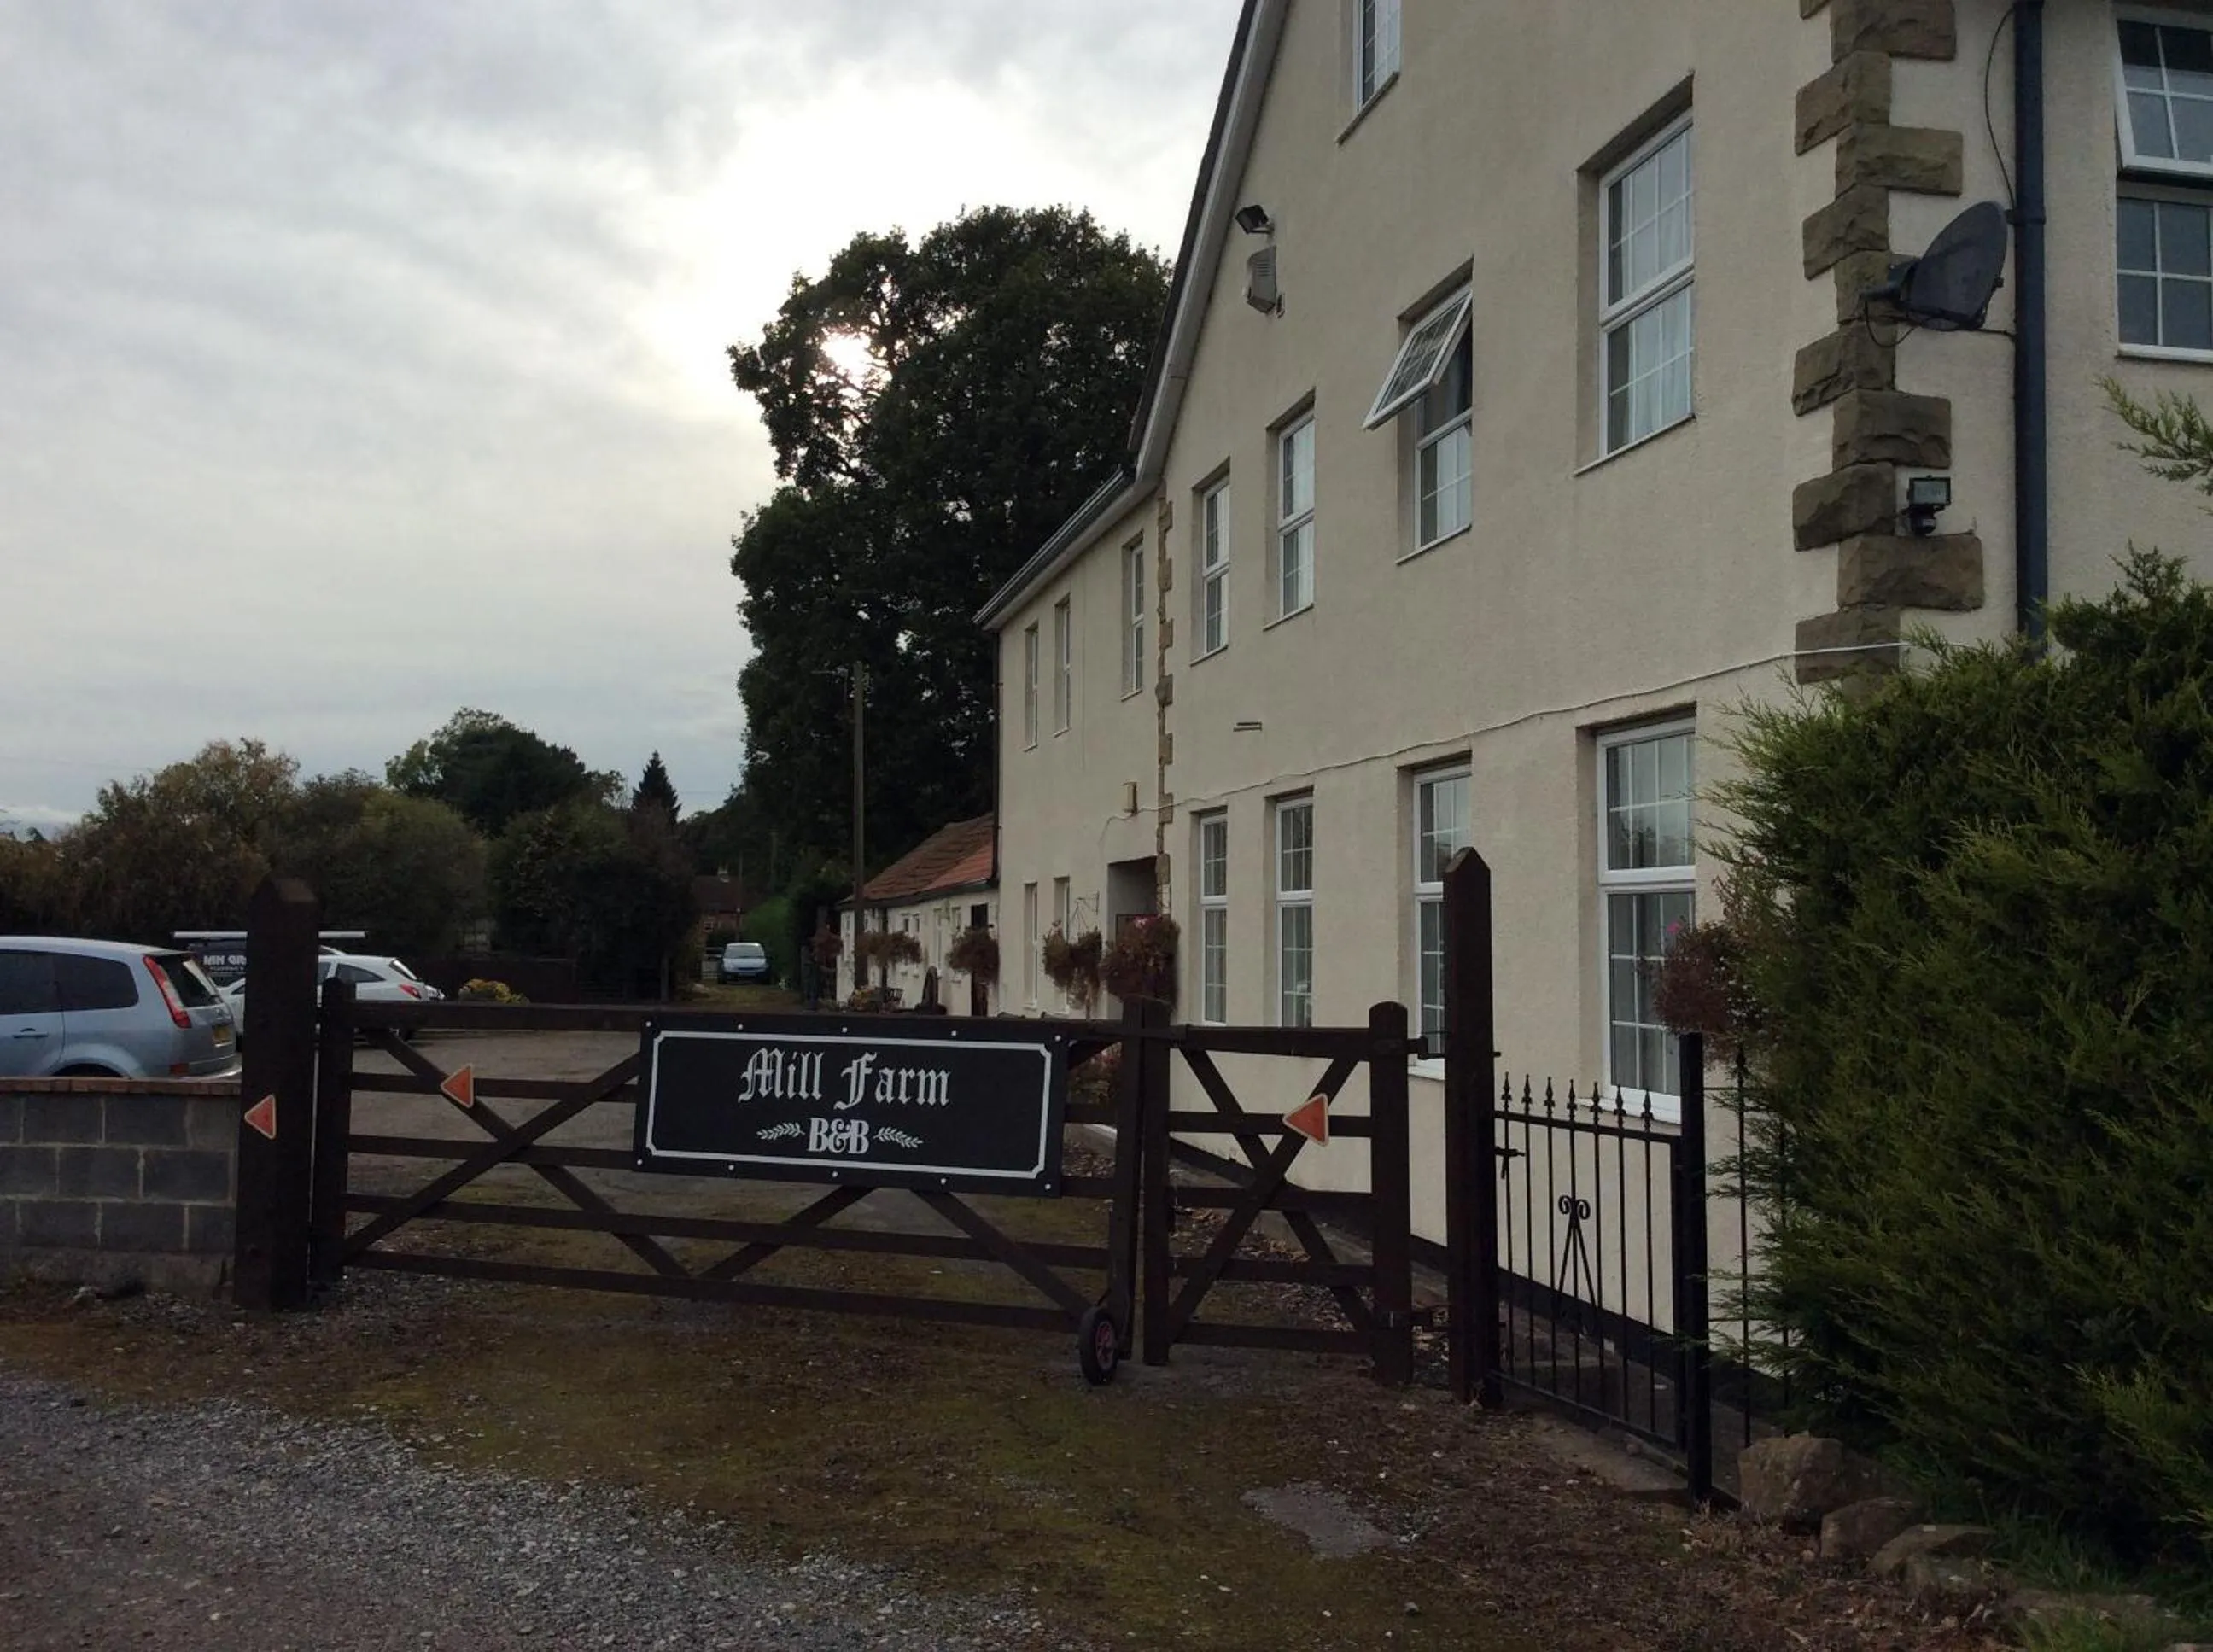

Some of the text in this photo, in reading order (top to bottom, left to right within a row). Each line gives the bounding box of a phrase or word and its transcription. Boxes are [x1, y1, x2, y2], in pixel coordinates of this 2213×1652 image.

[739, 1048, 951, 1111] Mill Farm
[808, 1117, 870, 1154] B&B
